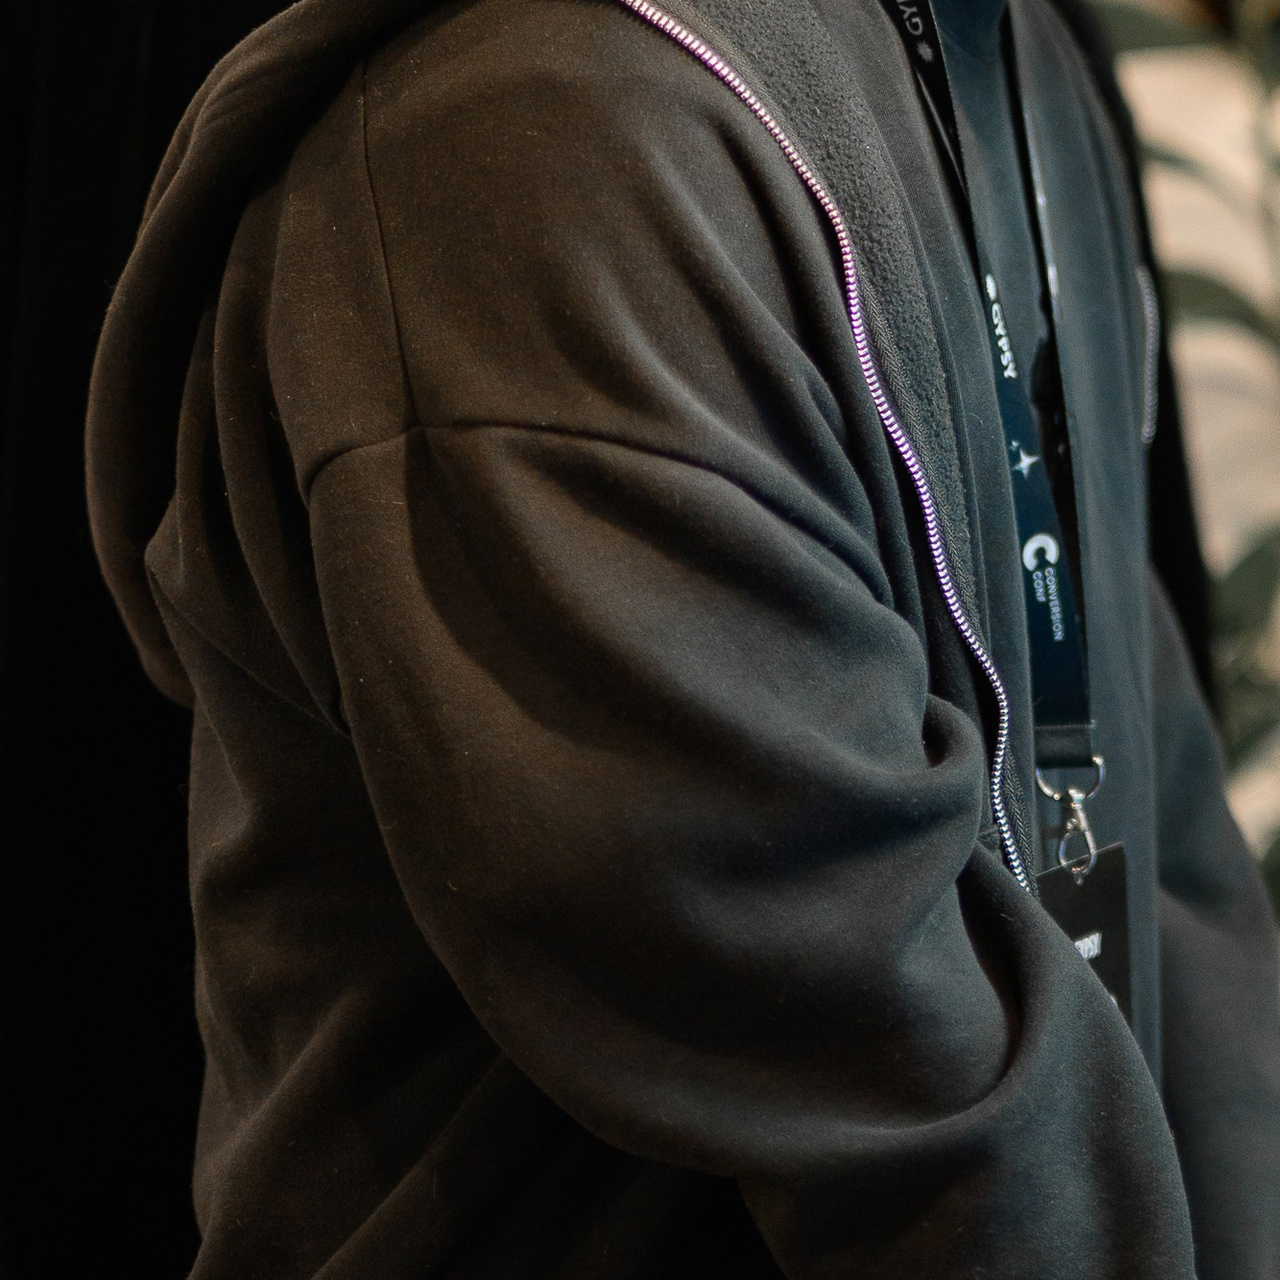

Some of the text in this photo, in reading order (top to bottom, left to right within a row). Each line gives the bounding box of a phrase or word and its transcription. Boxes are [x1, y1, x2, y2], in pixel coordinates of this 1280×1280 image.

[991, 302, 1018, 379] GYPSY
[1032, 571, 1046, 602] CONF
[1045, 567, 1064, 641] CONVERSION
